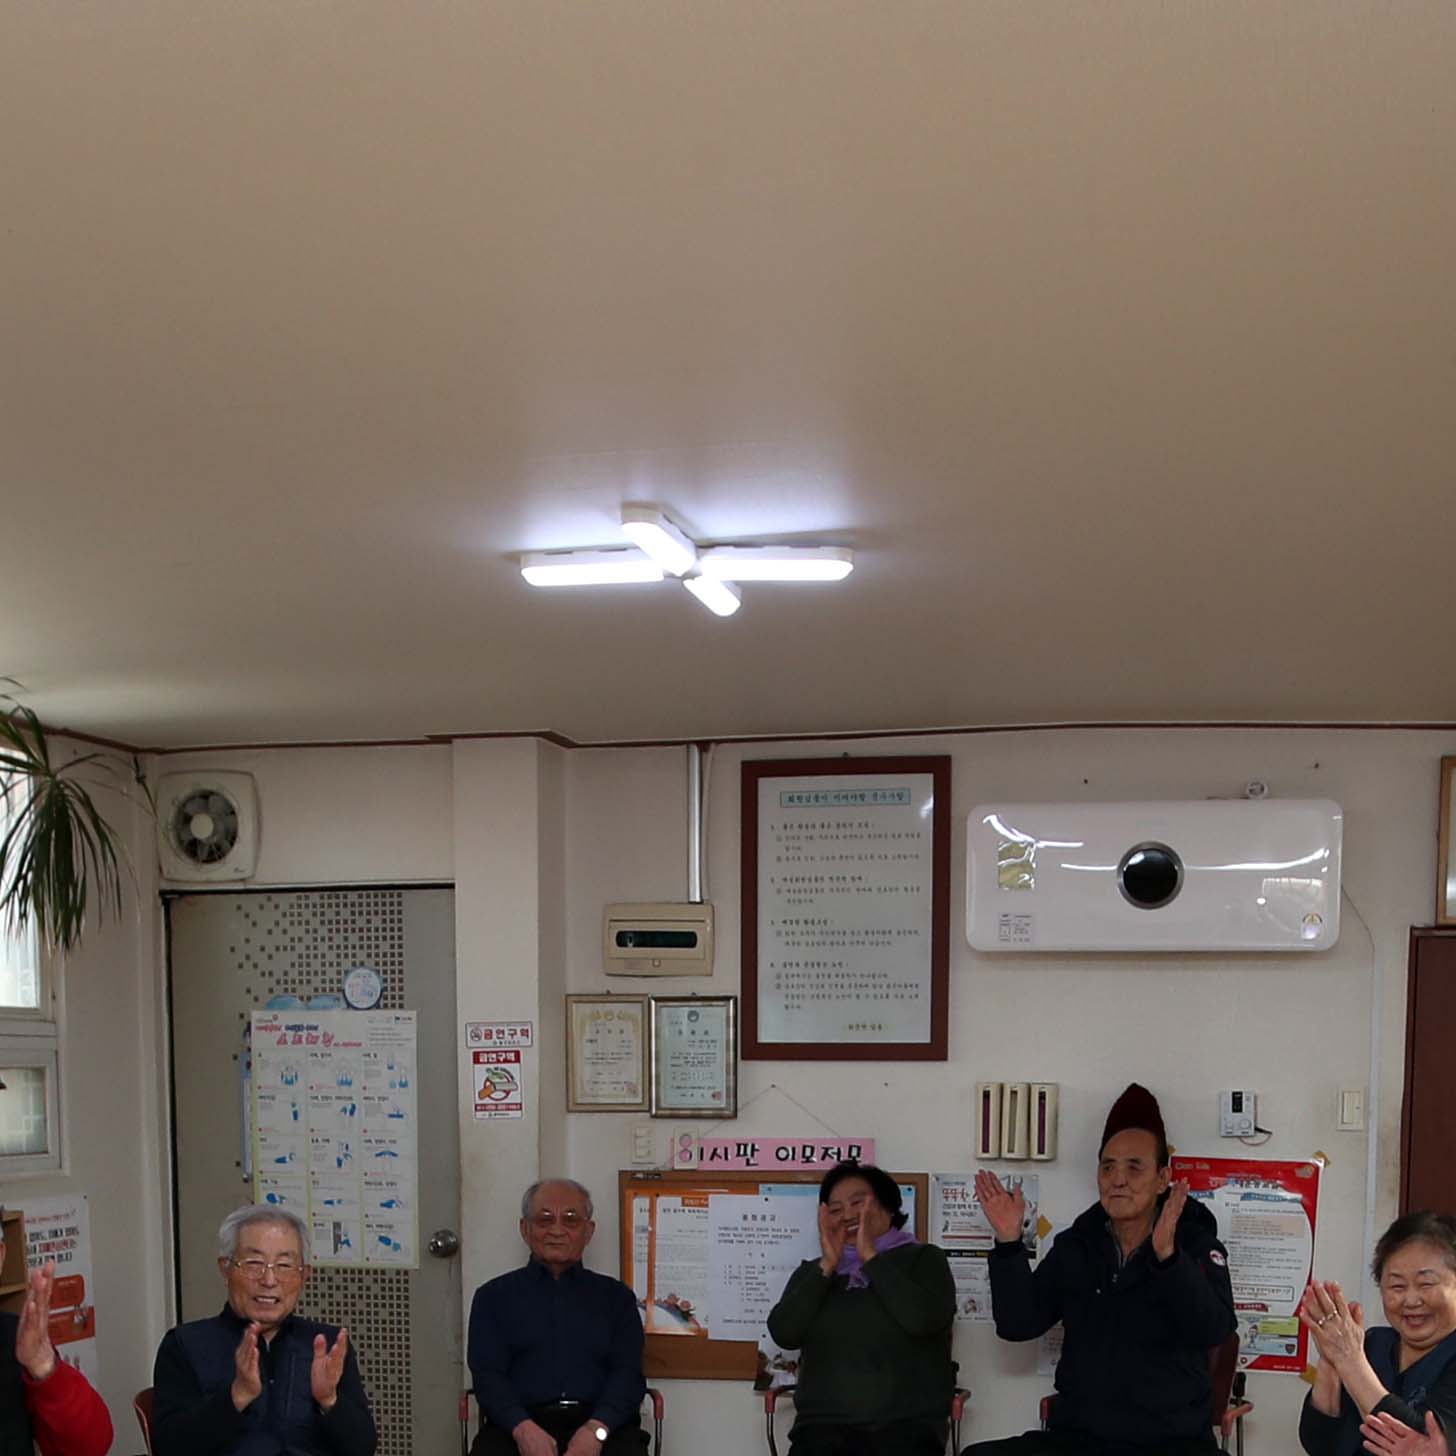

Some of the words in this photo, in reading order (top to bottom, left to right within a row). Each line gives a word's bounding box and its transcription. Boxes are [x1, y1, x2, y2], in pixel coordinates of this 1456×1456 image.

[484, 1027, 529, 1040] 금연구역
[479, 1052, 516, 1063] 금연구역
[698, 1143, 760, 1167] 시판
[775, 1144, 863, 1164] 이모저모
